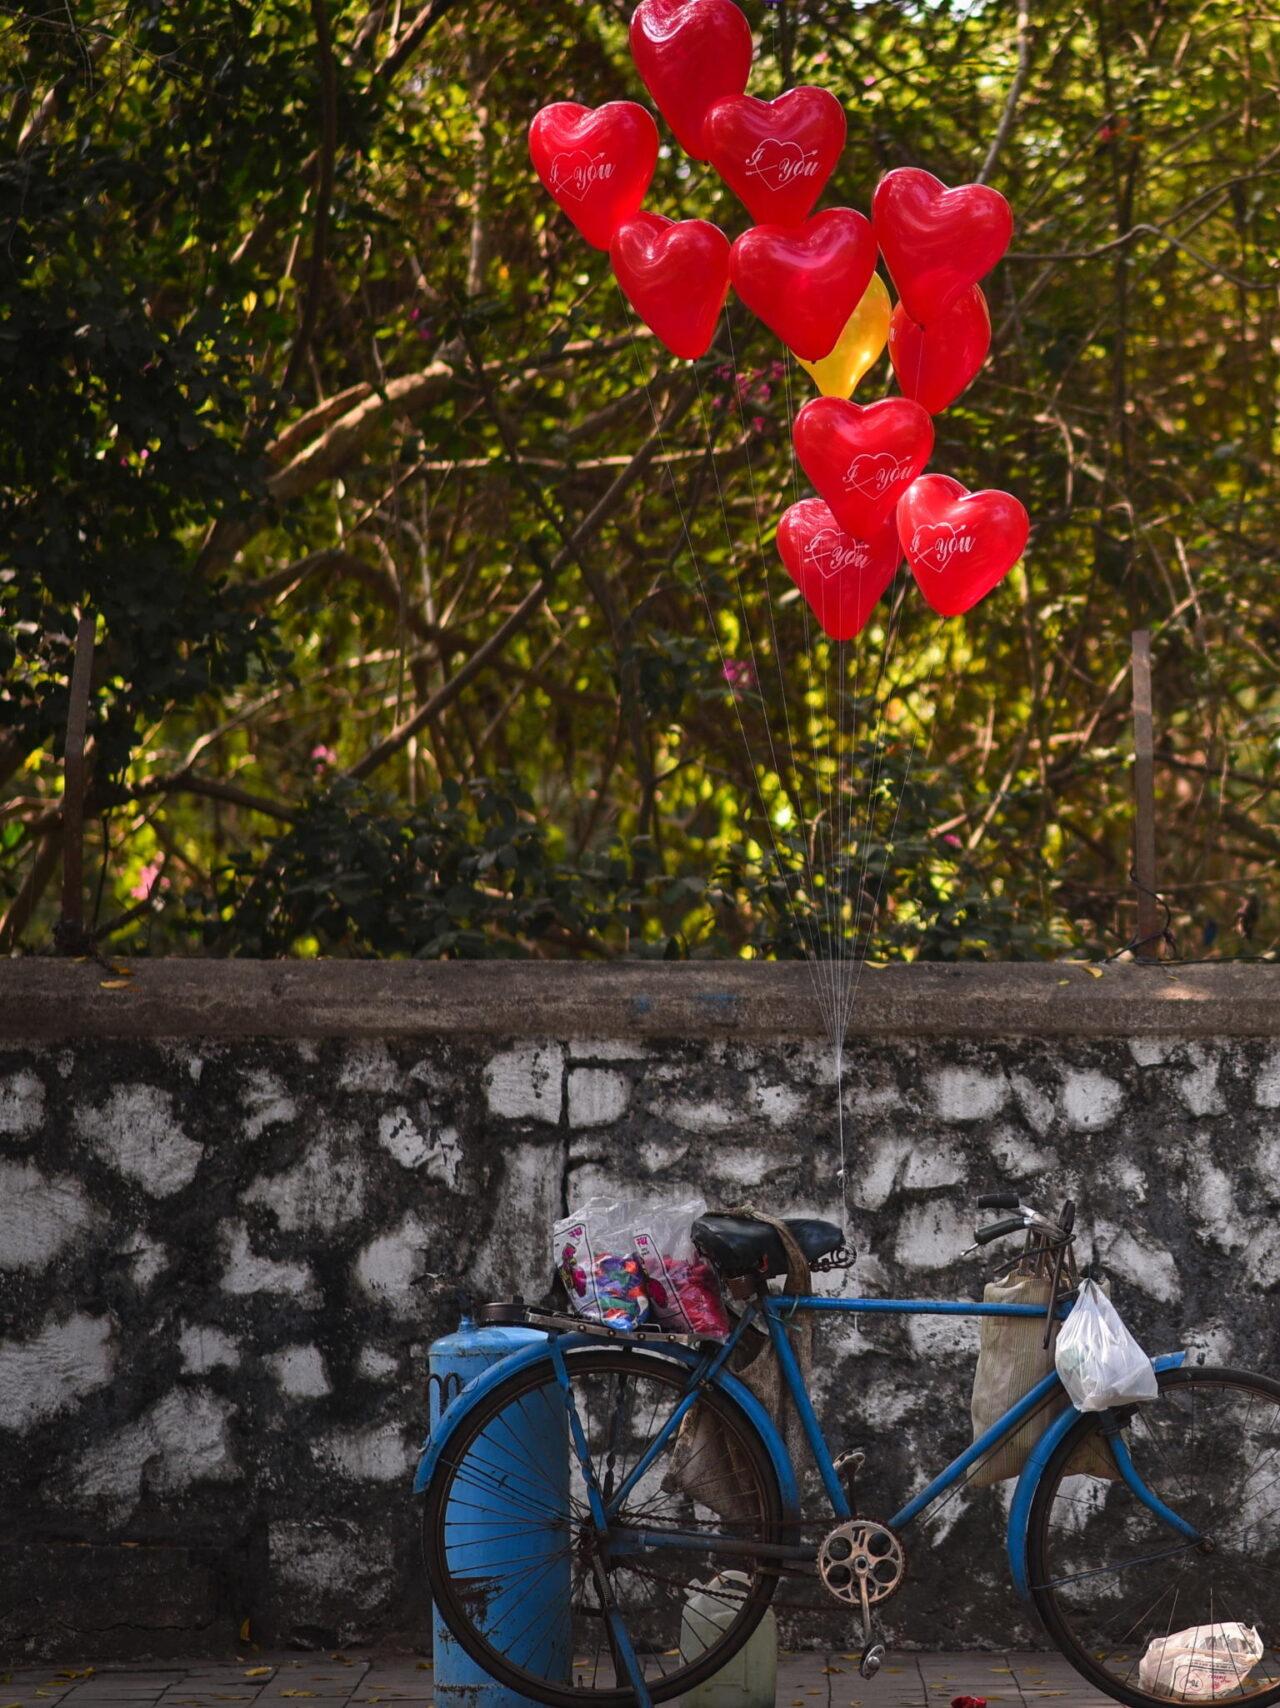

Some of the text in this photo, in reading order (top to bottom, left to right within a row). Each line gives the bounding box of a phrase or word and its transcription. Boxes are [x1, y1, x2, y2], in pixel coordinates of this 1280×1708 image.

[549, 163, 616, 190] I you
[745, 148, 821, 181] I you
[842, 465, 915, 490] I you
[804, 535, 823, 552] I
[909, 534, 976, 562] I you
